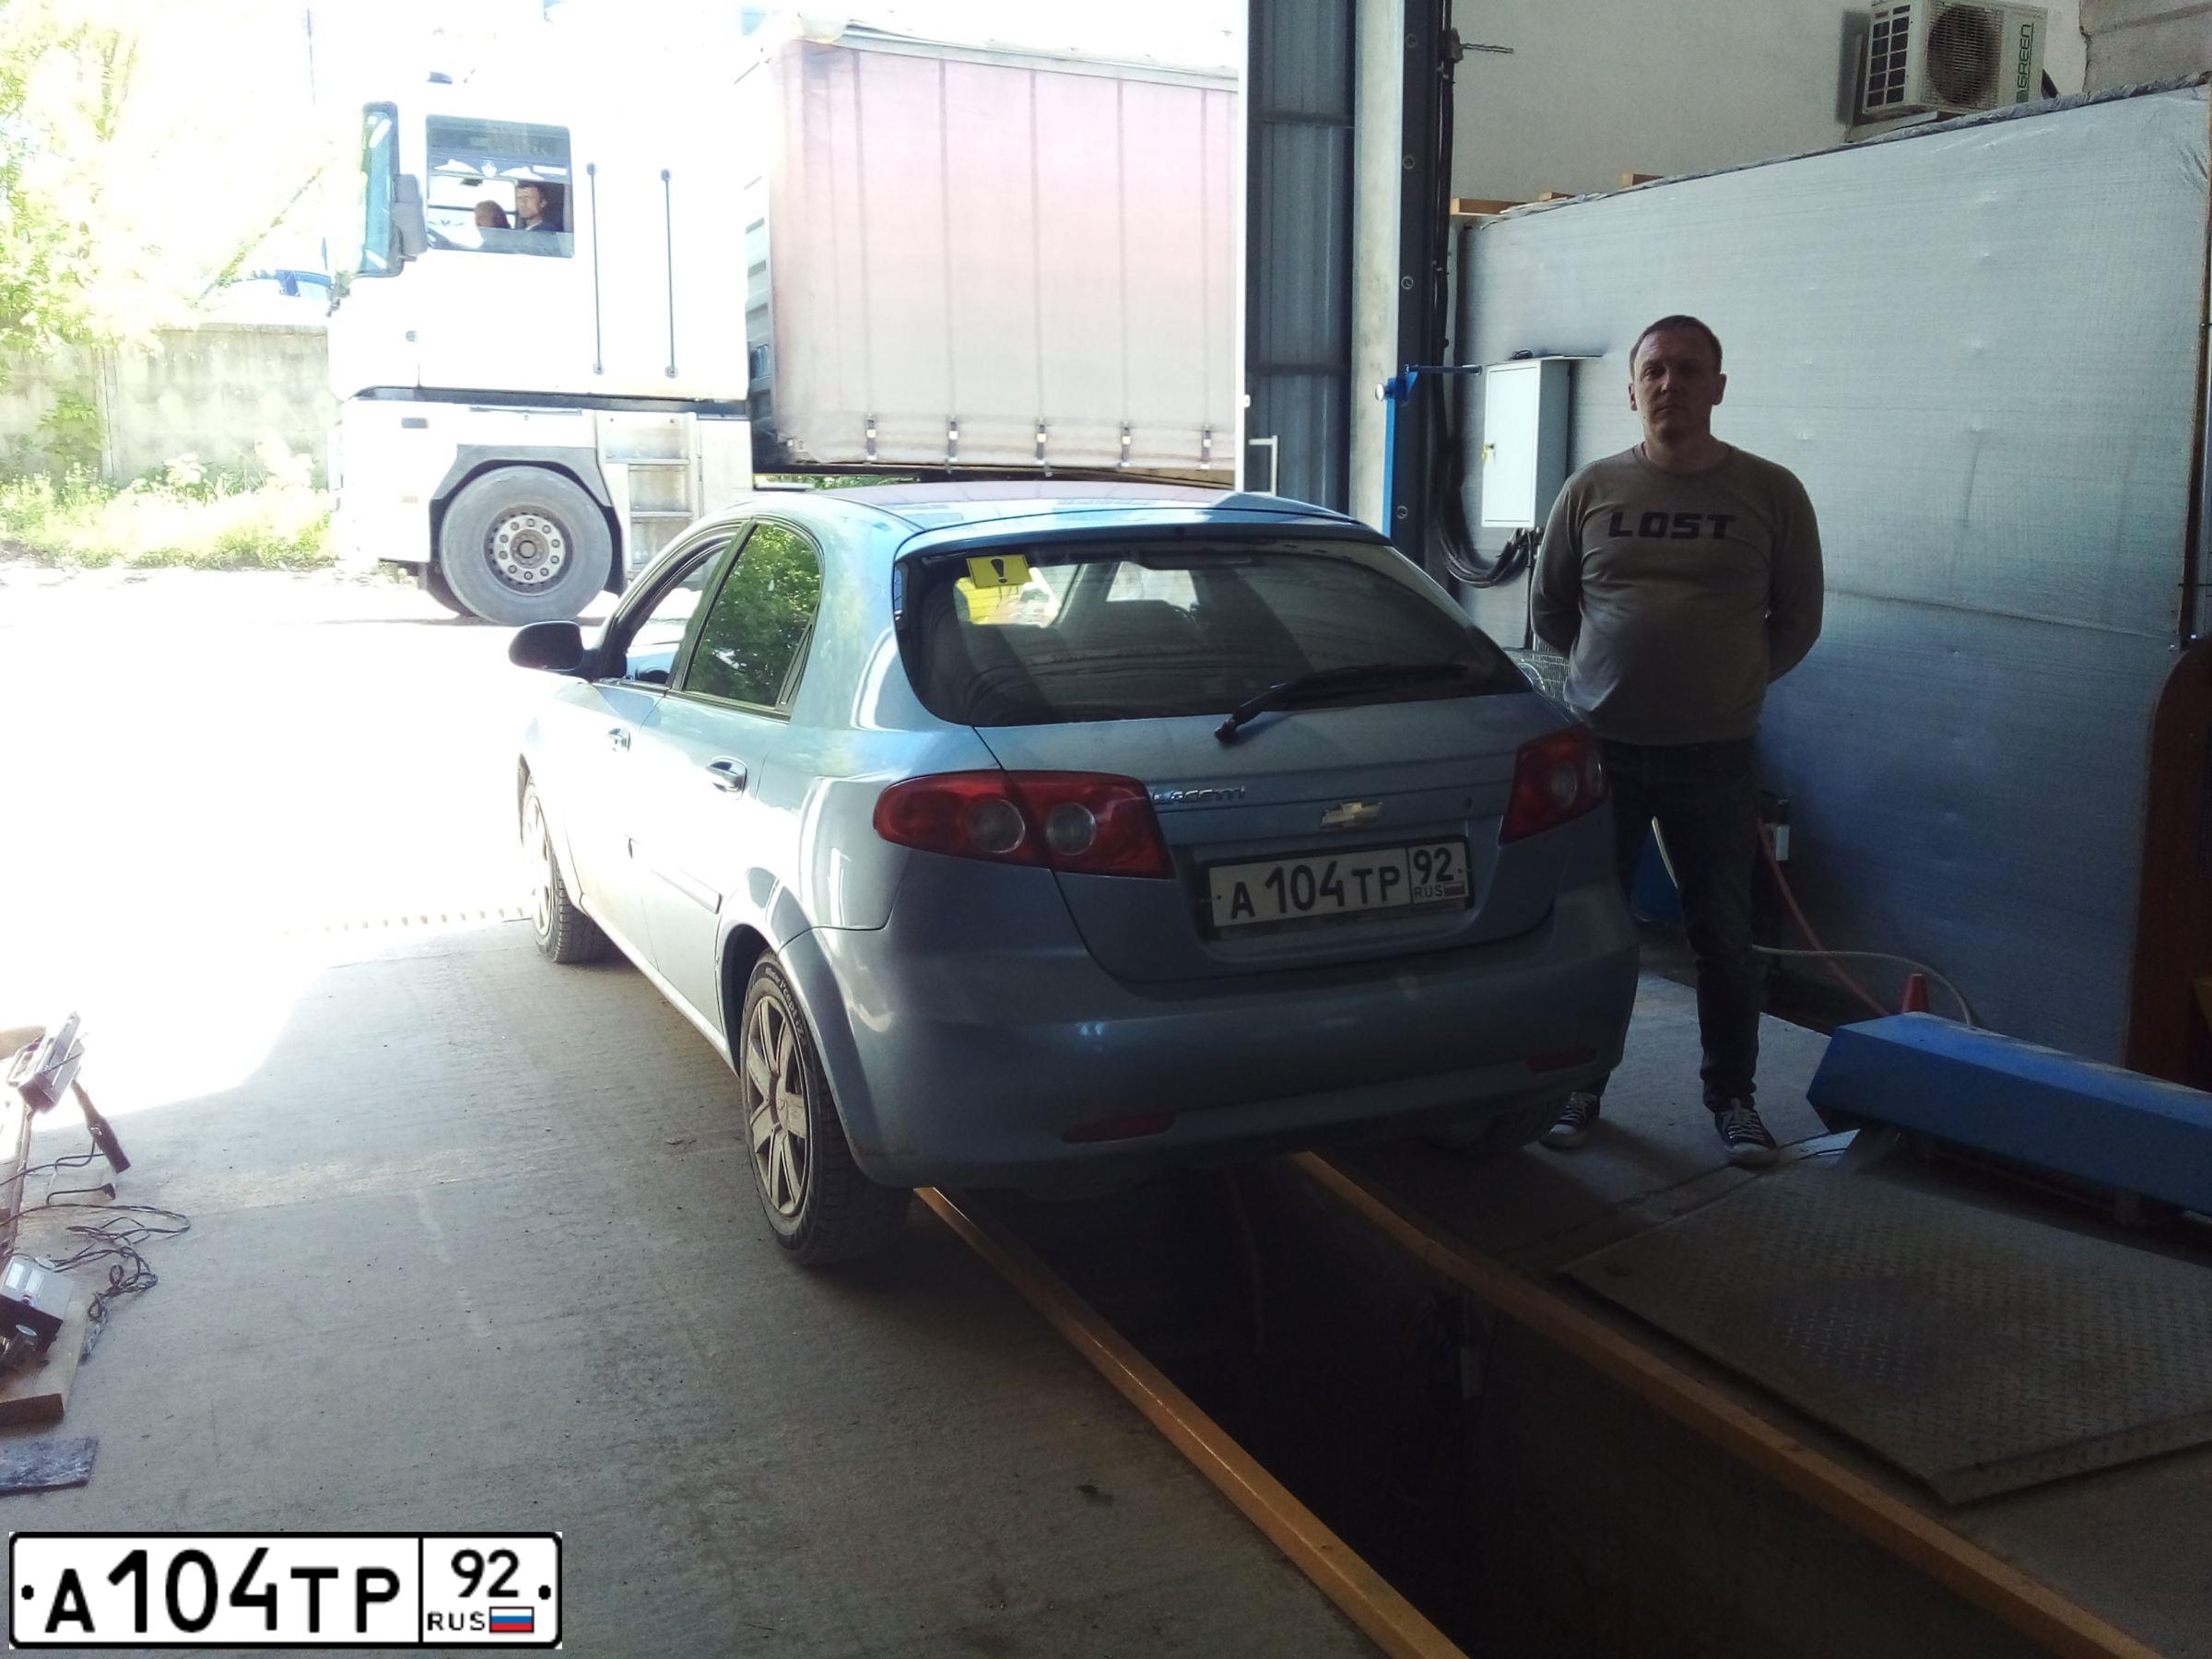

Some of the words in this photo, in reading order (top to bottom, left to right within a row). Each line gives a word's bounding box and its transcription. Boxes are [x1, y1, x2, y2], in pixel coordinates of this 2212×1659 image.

[2017, 24, 2030, 88] GREEN
[1608, 512, 1736, 539] LOST
[1414, 847, 1454, 884] 92
[1414, 884, 1443, 900] RUS
